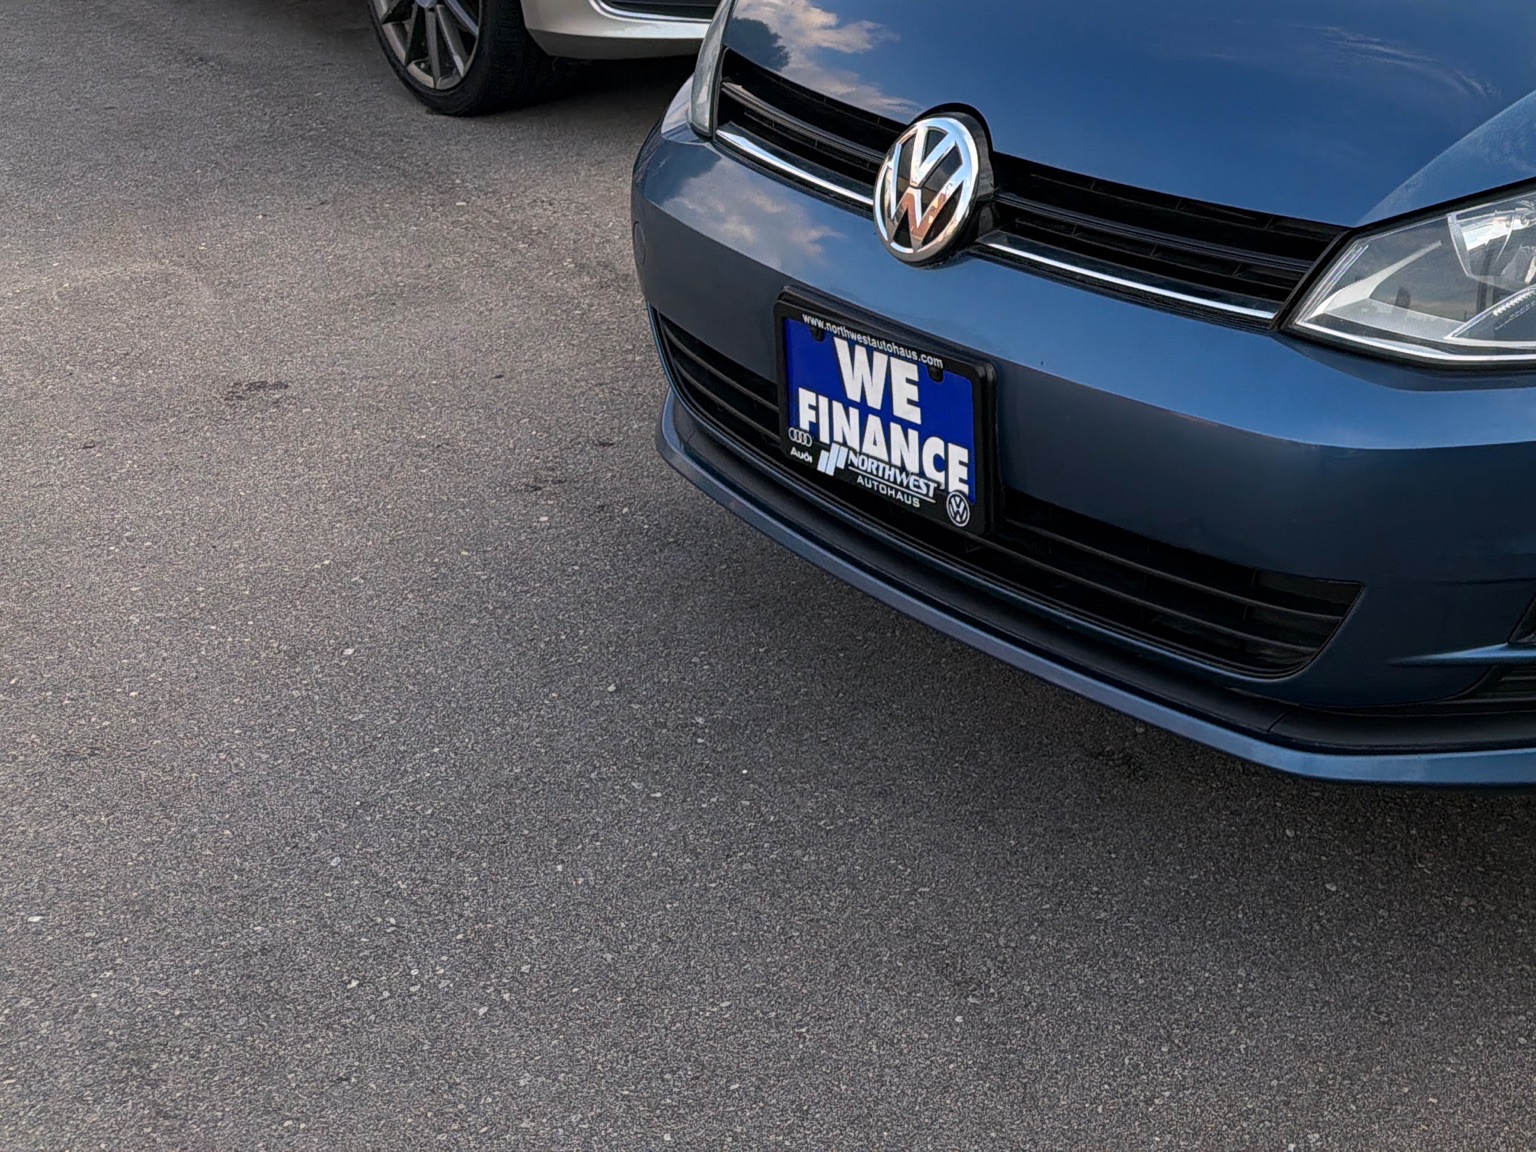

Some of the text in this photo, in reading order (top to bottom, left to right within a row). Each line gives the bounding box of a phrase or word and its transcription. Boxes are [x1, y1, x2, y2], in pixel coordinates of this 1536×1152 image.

[802, 313, 944, 369] www.northwestautohaus.com
[833, 336, 922, 425] WE
[798, 387, 969, 496] FINANCE
[847, 451, 938, 498] NORTHWEST
[856, 474, 921, 508] AUTOHAUS
